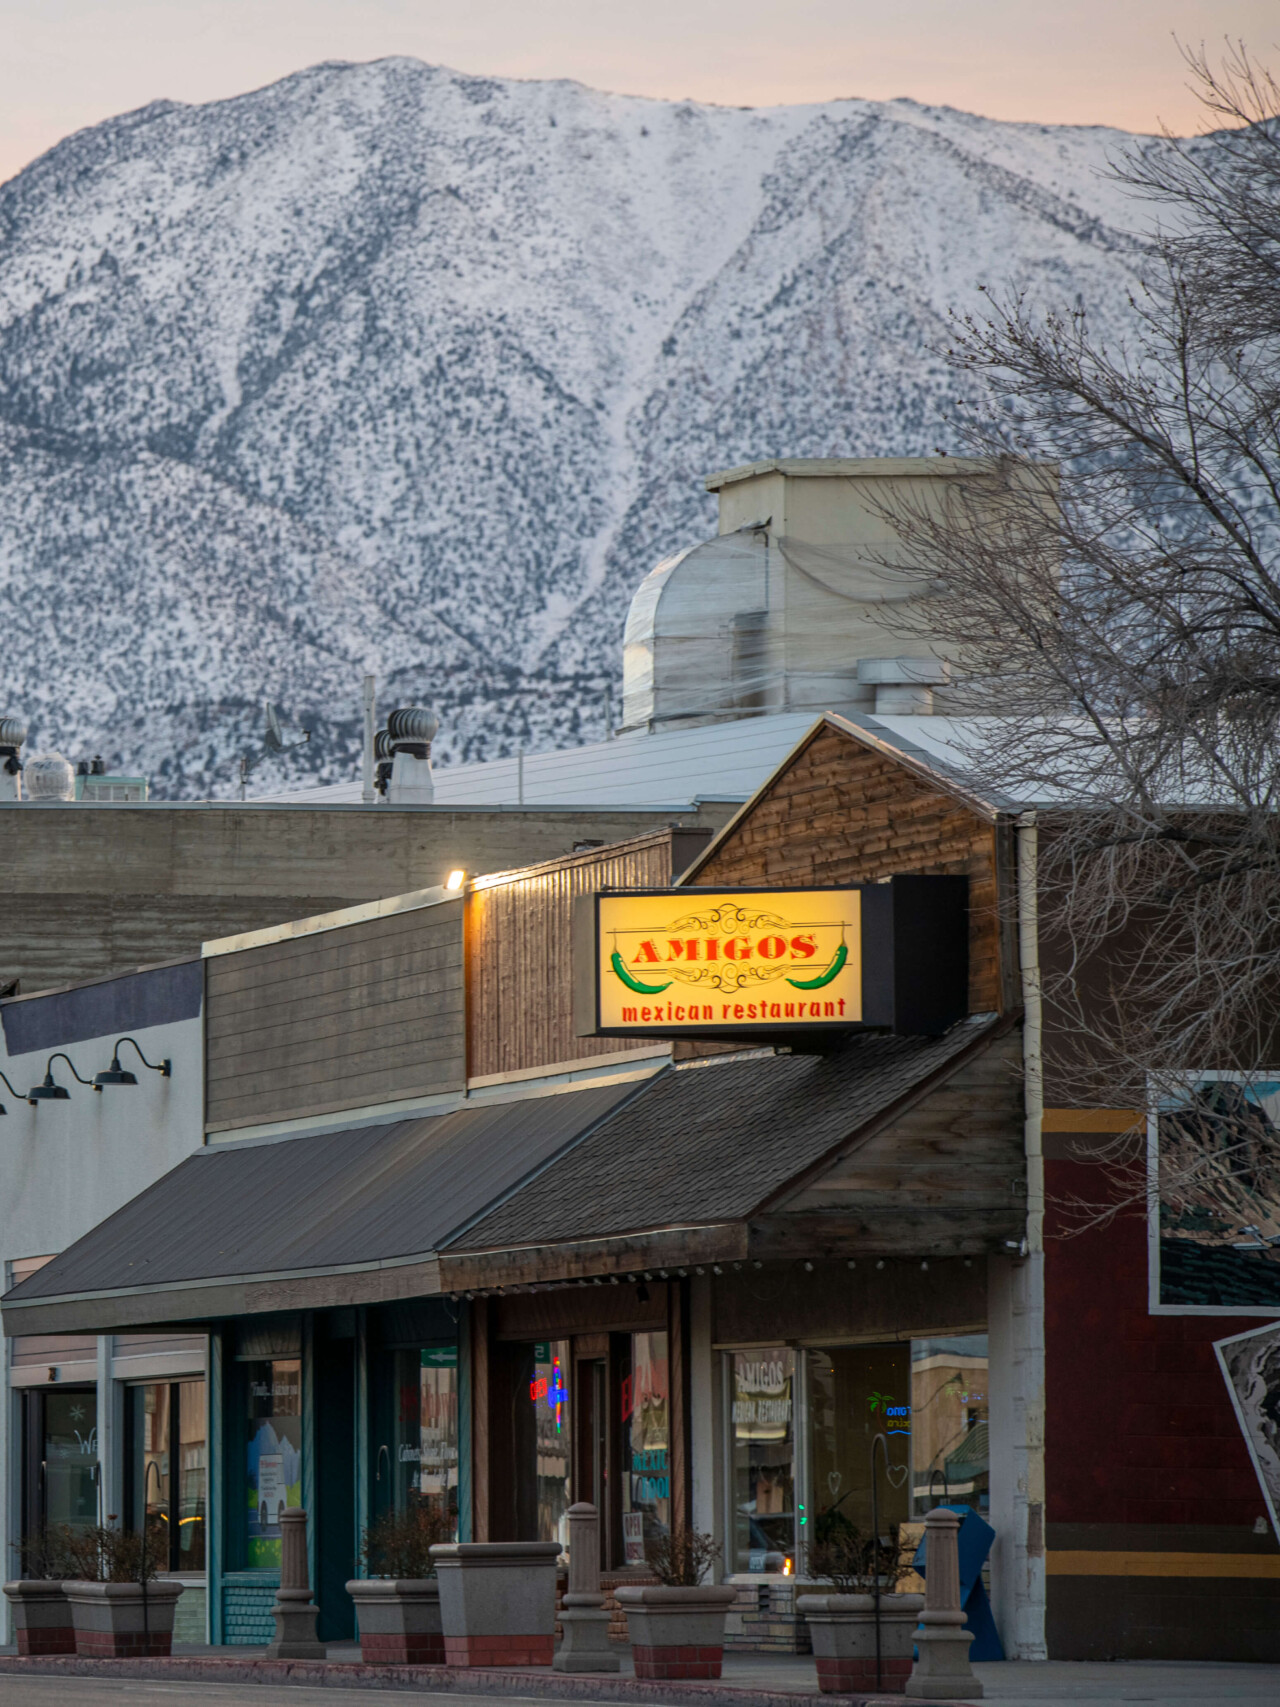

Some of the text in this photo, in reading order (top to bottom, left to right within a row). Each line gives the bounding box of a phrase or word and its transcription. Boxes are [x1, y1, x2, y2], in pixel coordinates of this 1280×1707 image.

[631, 934, 819, 964] AMIGOS
[621, 998, 847, 1023] mexican restaurant
[737, 1361, 785, 1392] AMIGOS
[632, 1449, 668, 1471] MEXIC
